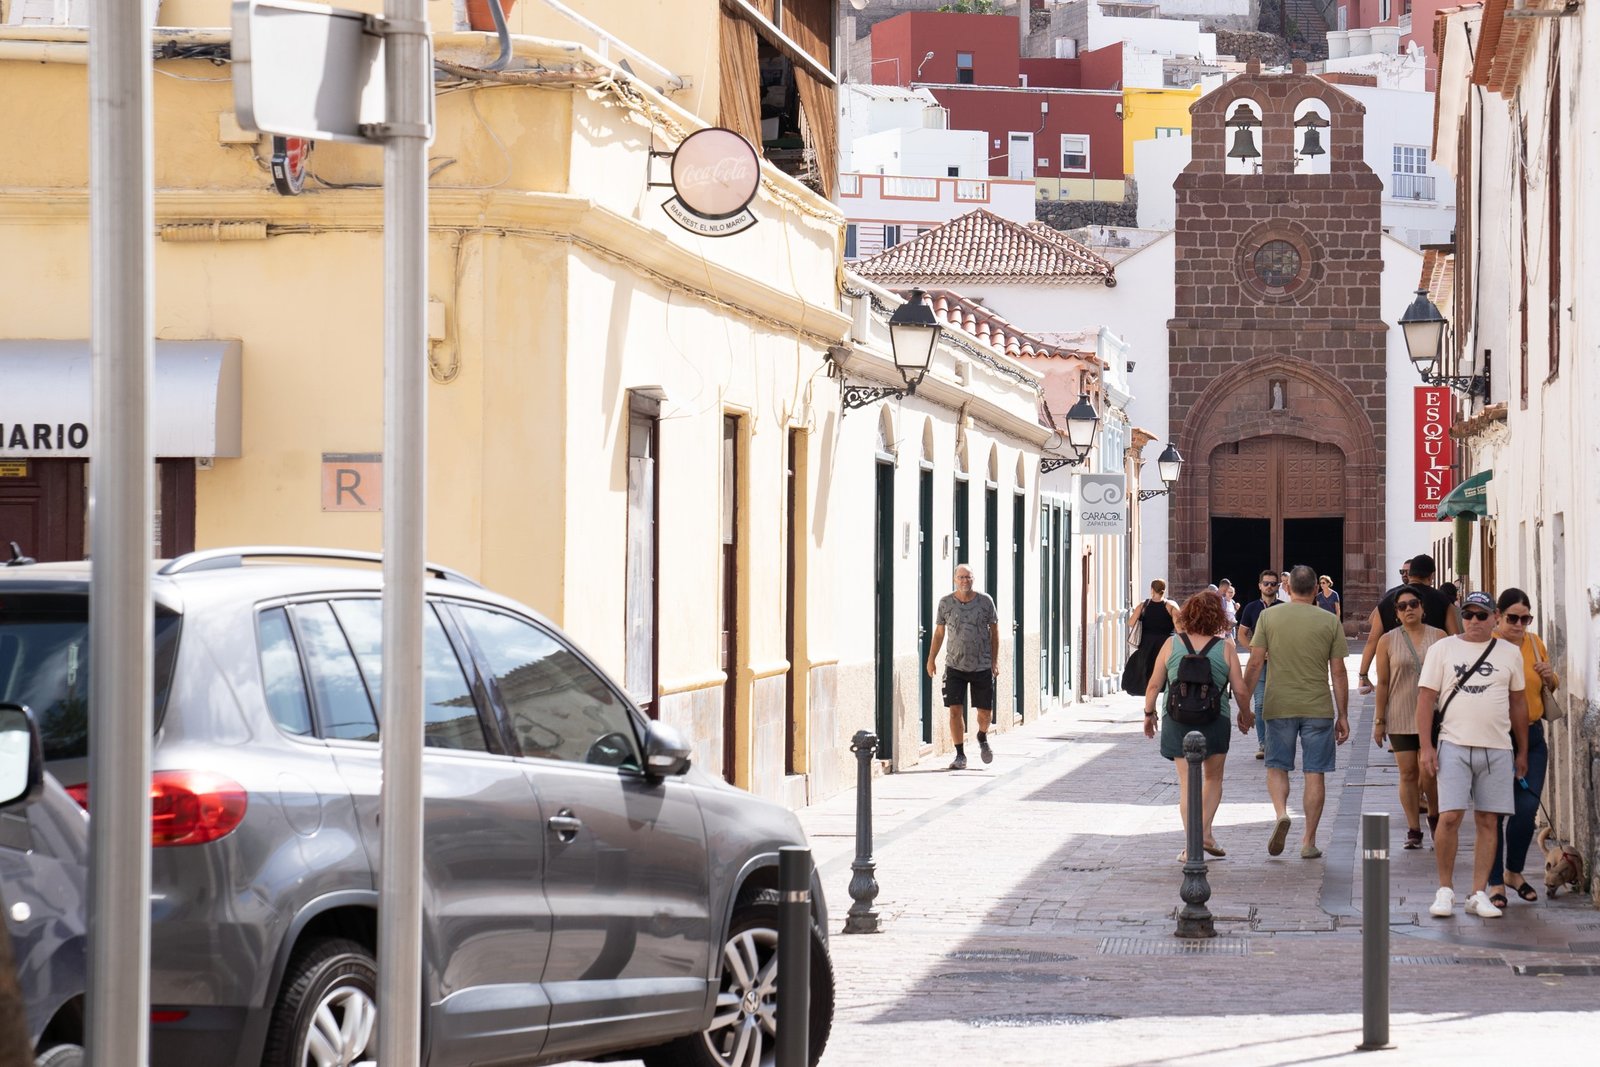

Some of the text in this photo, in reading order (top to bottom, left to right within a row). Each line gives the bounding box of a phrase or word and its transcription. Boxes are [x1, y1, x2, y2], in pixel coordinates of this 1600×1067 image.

[670, 204, 746, 232] BAR REST. EL NILO MARIO
[336, 468, 367, 506] R
[1081, 511, 1123, 521] CARACOL
